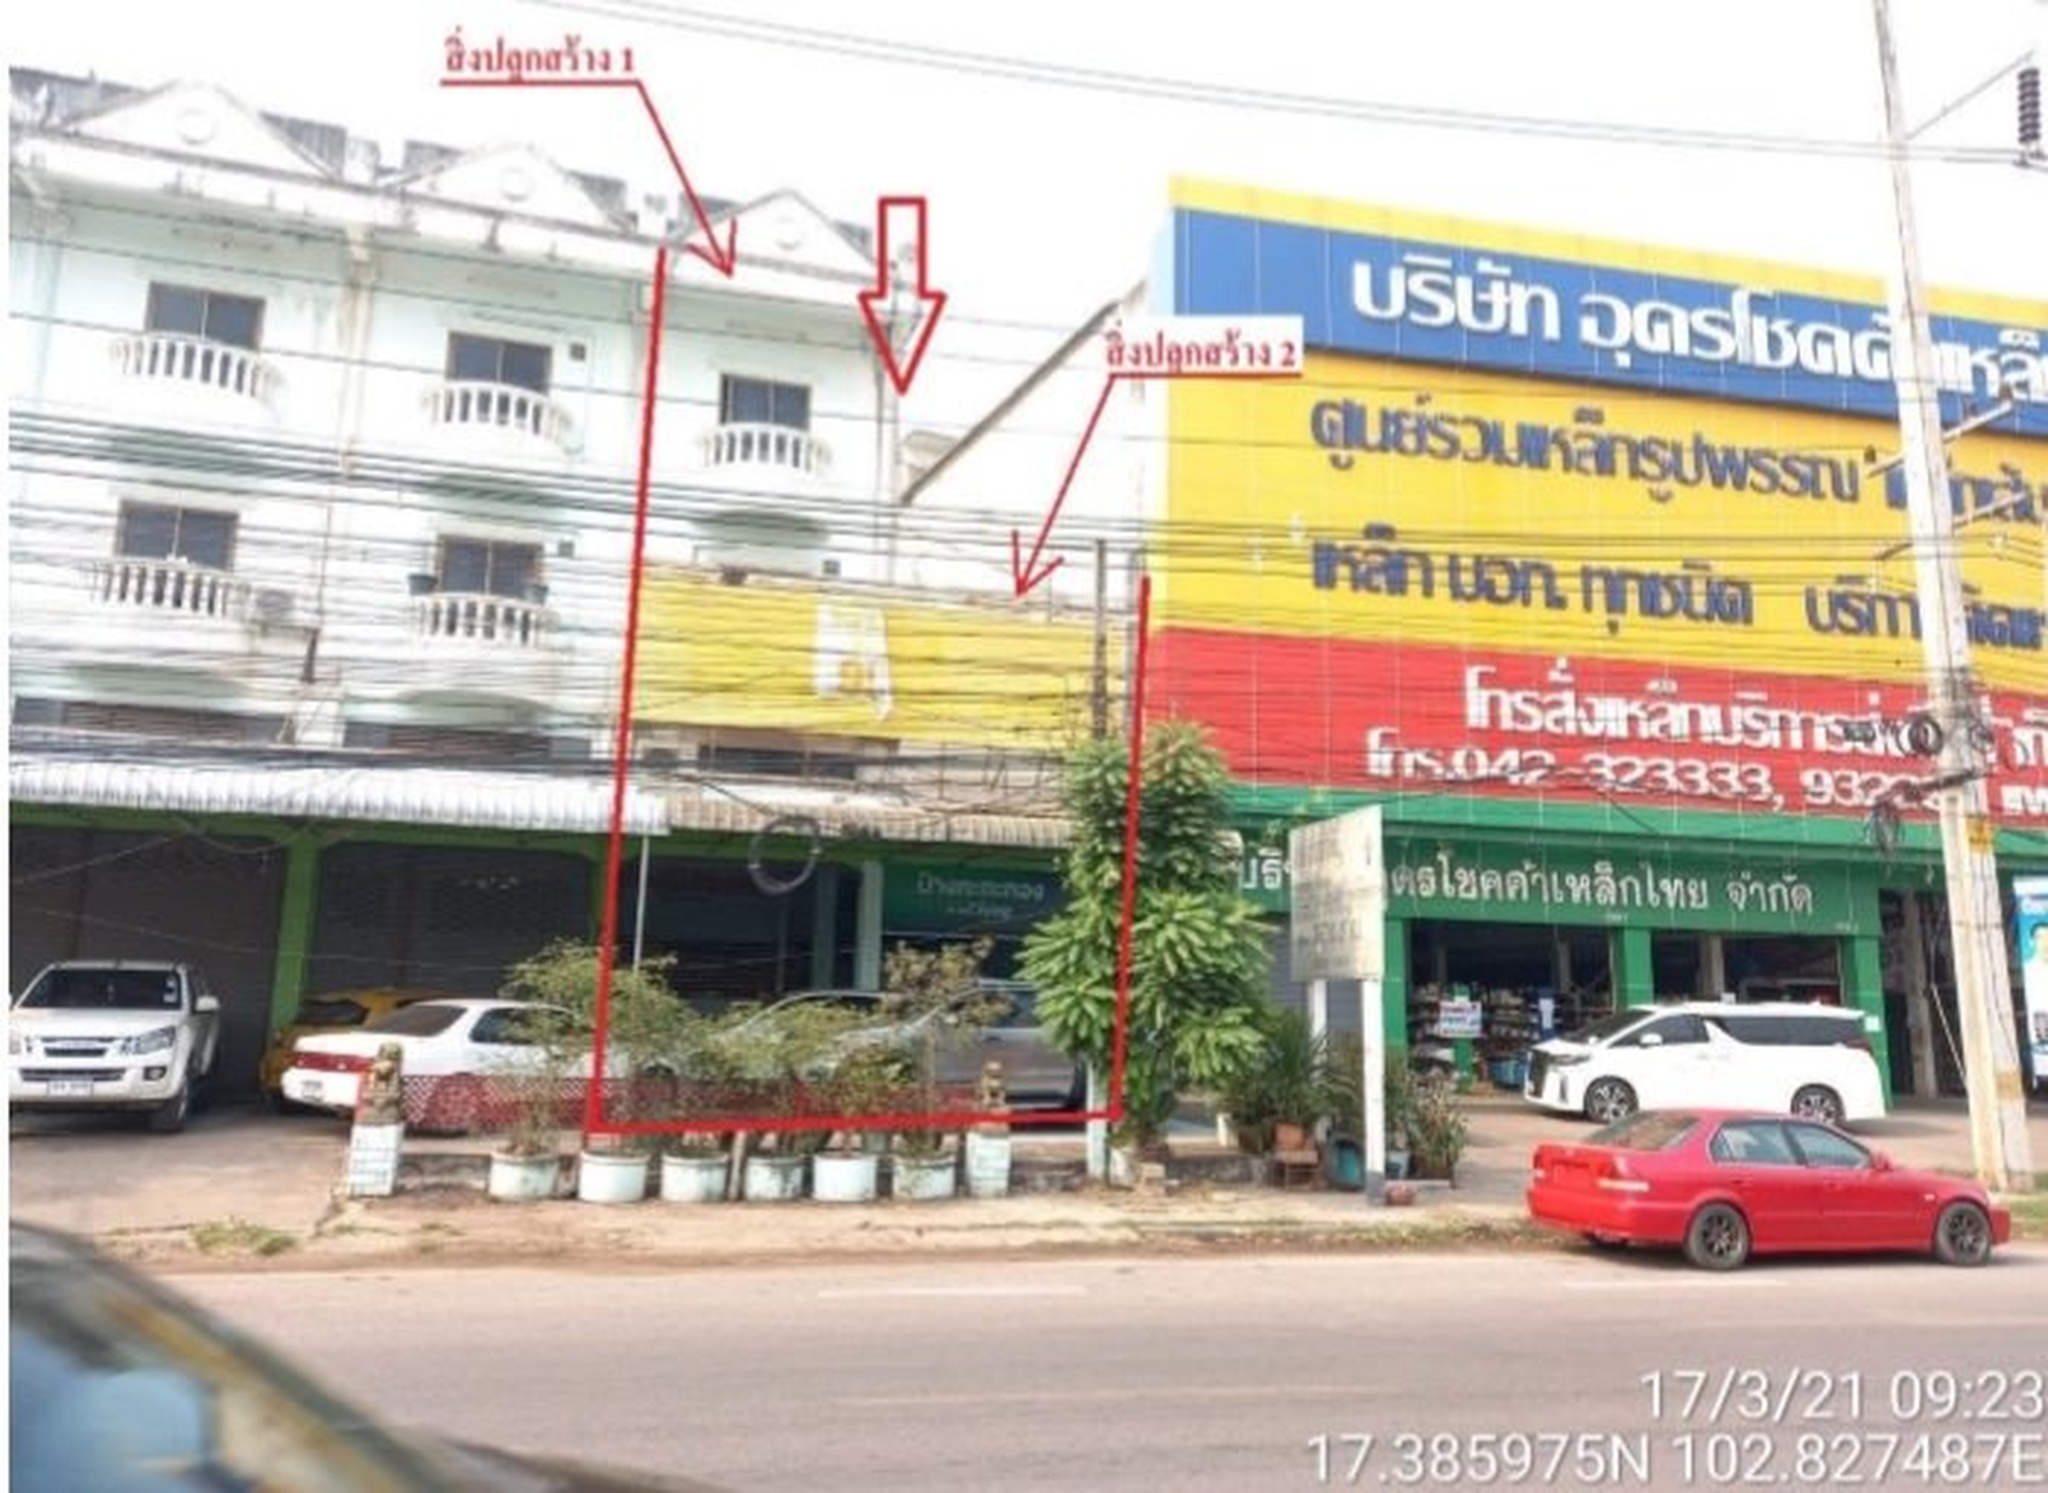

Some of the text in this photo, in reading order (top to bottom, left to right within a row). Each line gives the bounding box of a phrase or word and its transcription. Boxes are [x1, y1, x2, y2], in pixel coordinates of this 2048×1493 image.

[1352, 253, 1561, 341] บริษัท
[1311, 522, 1434, 598] เหล็ก
[1727, 869, 1814, 916] จำกัด
